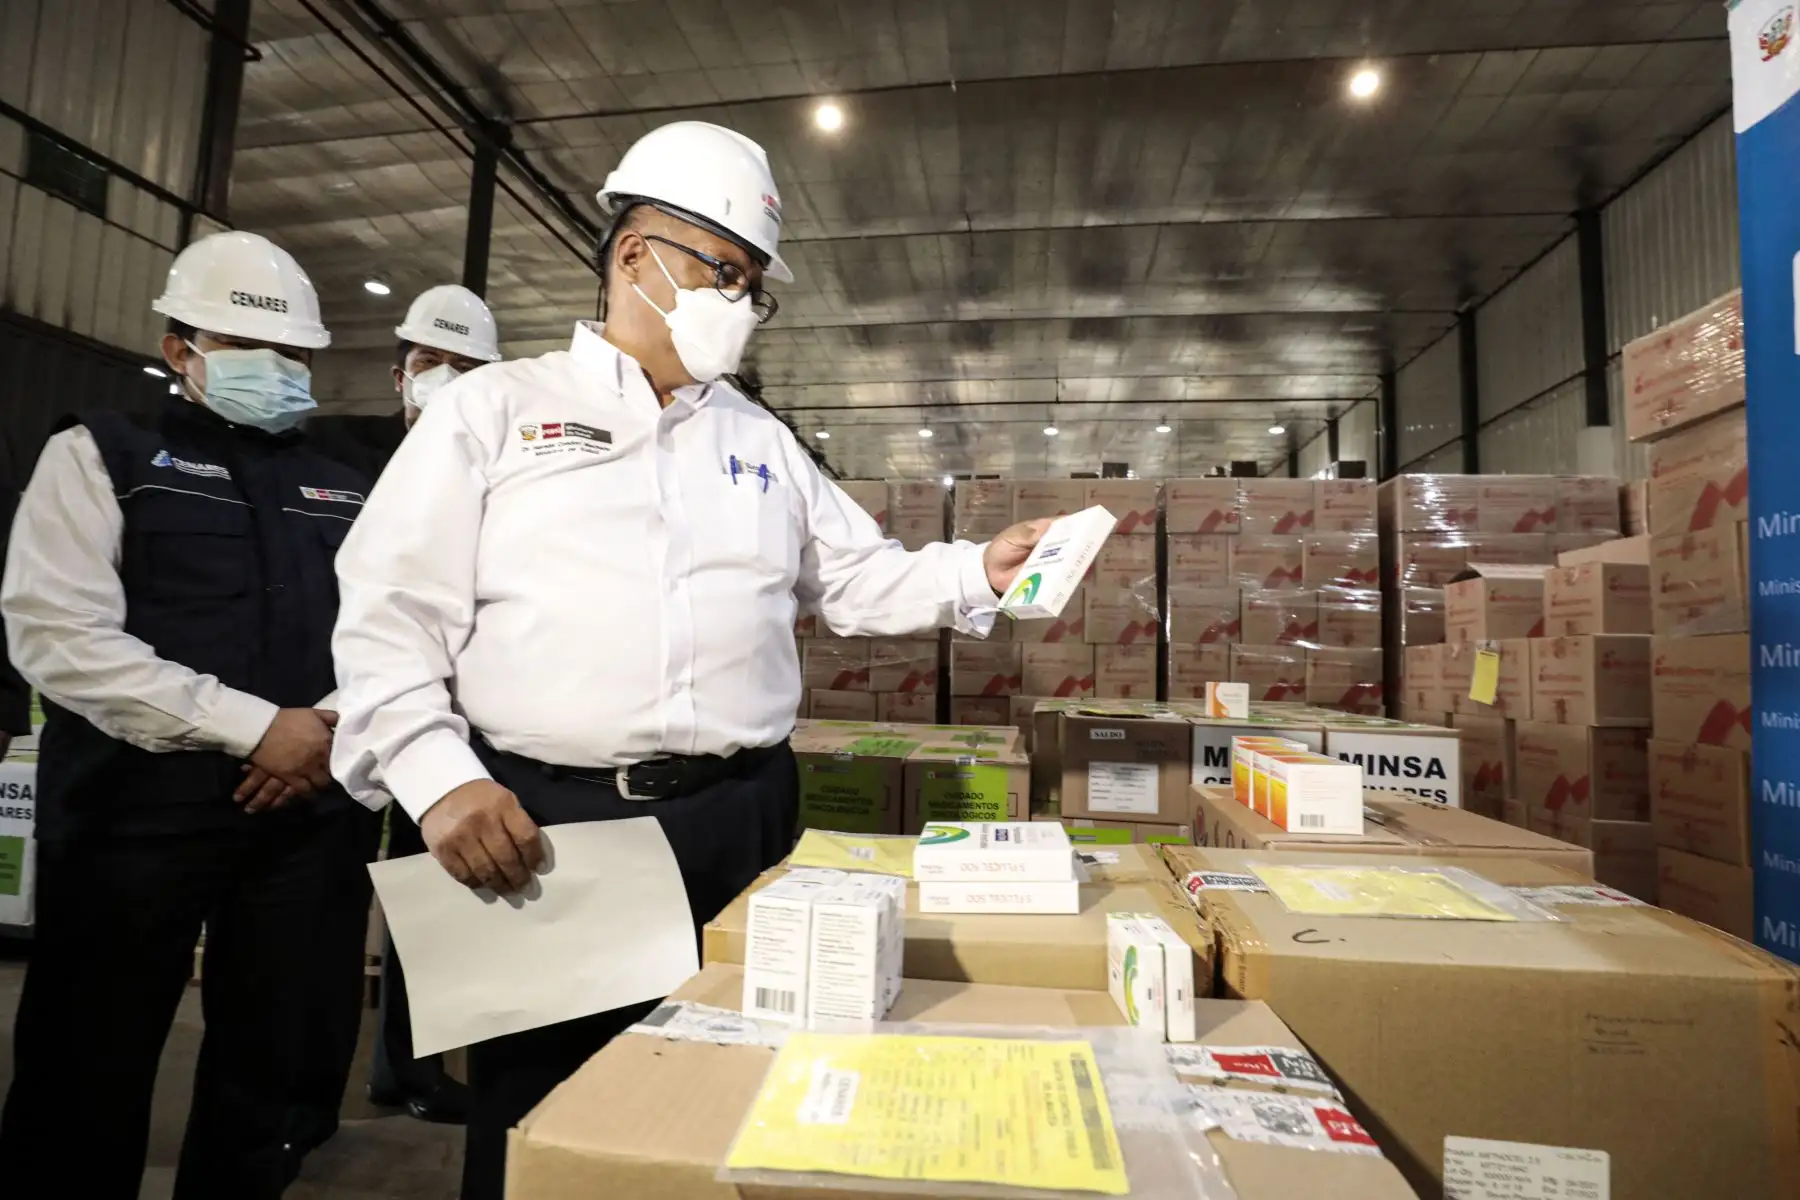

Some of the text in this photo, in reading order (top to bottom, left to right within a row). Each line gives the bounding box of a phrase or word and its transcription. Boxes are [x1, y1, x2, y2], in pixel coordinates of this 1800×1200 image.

[230, 290, 288, 315] CENARES
[433, 317, 470, 336] CENARES
[1094, 731, 1123, 739] SALDO
[1340, 752, 1447, 780] MINSA
[943, 791, 984, 800] CUIDADO
[928, 799, 1000, 810] MEDICAMENTOS
